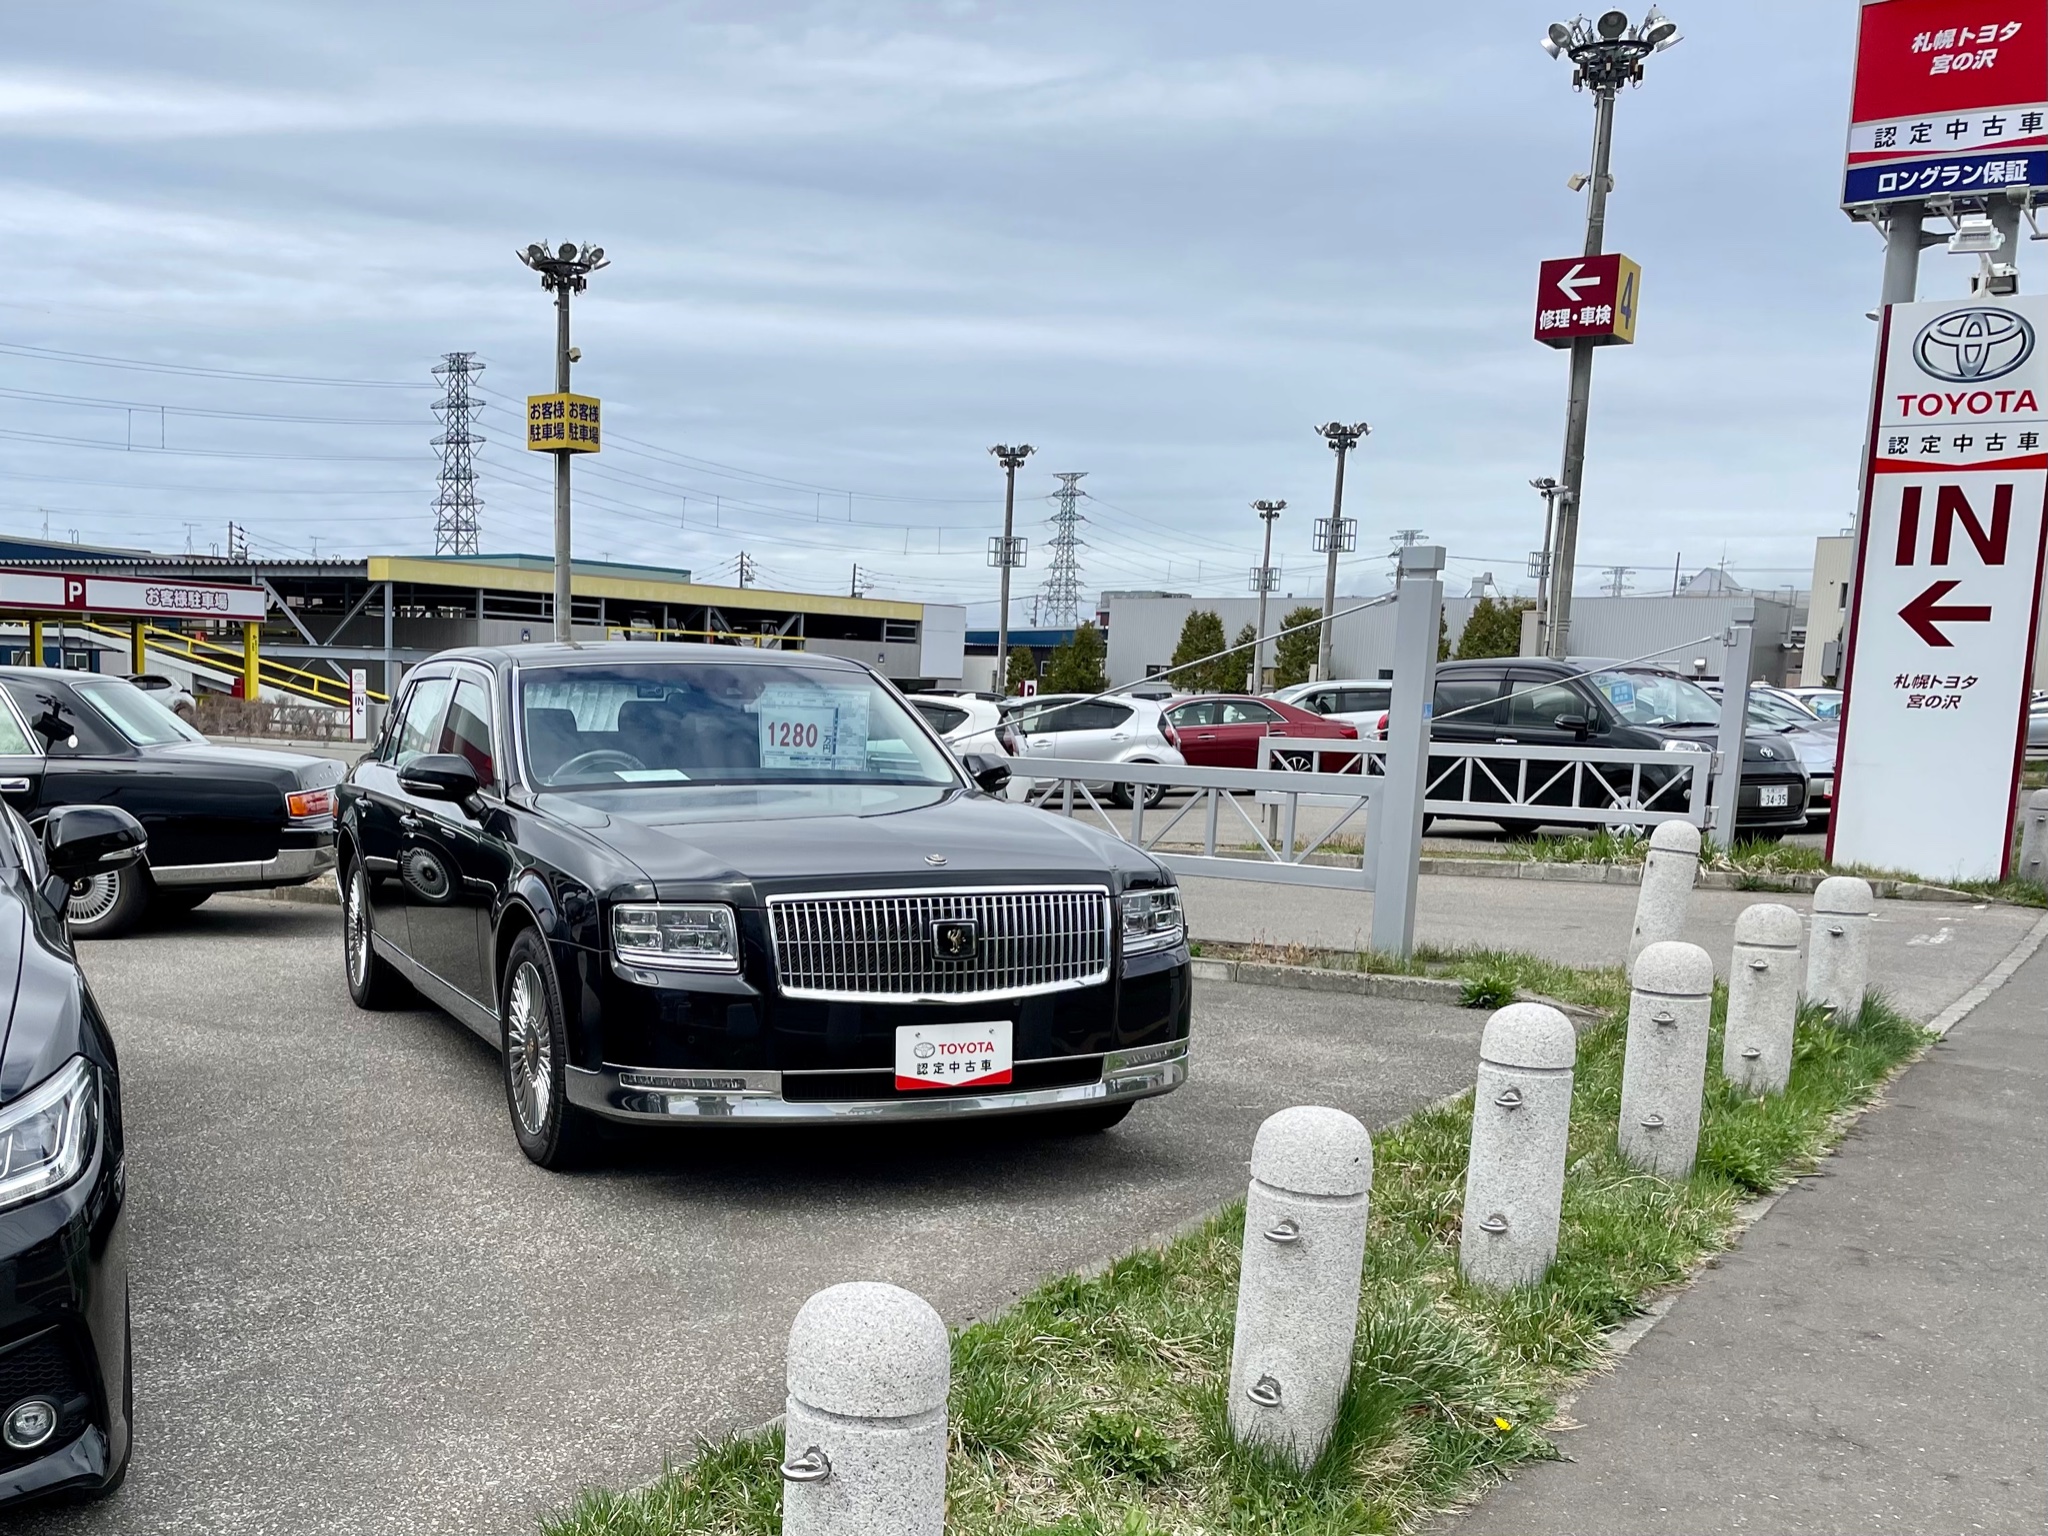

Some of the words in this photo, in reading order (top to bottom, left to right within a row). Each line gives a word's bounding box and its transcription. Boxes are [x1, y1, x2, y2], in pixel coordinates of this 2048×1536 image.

[1911, 21, 2022, 53] 札幌トヨタ
[1930, 49, 1998, 75] 宮の沢
[1874, 112, 2043, 148] 認定中古車
[1878, 160, 2028, 192] ロングラン保証
[1621, 272, 1633, 329] 4
[1540, 304, 1612, 330] 修理・車検
[530, 400, 565, 420] お客様
[569, 402, 599, 422] お客様
[1897, 390, 2038, 417] TOYOTA
[530, 422, 565, 442] 駐車場
[569, 422, 599, 444] 駐車場
[1888, 431, 2039, 455] 認定中古車
[1895, 484, 2014, 566] IN
[69, 582, 82, 602] P
[146, 588, 228, 611] お客様駐車場
[1893, 674, 1978, 690] 札幌トヨタ
[355, 696, 364, 706] IN
[1906, 694, 1961, 709] 宮の沢
[768, 721, 818, 748] 1280
[939, 1042, 994, 1055] TOYOTA
[916, 1059, 992, 1075] 認定中古車
